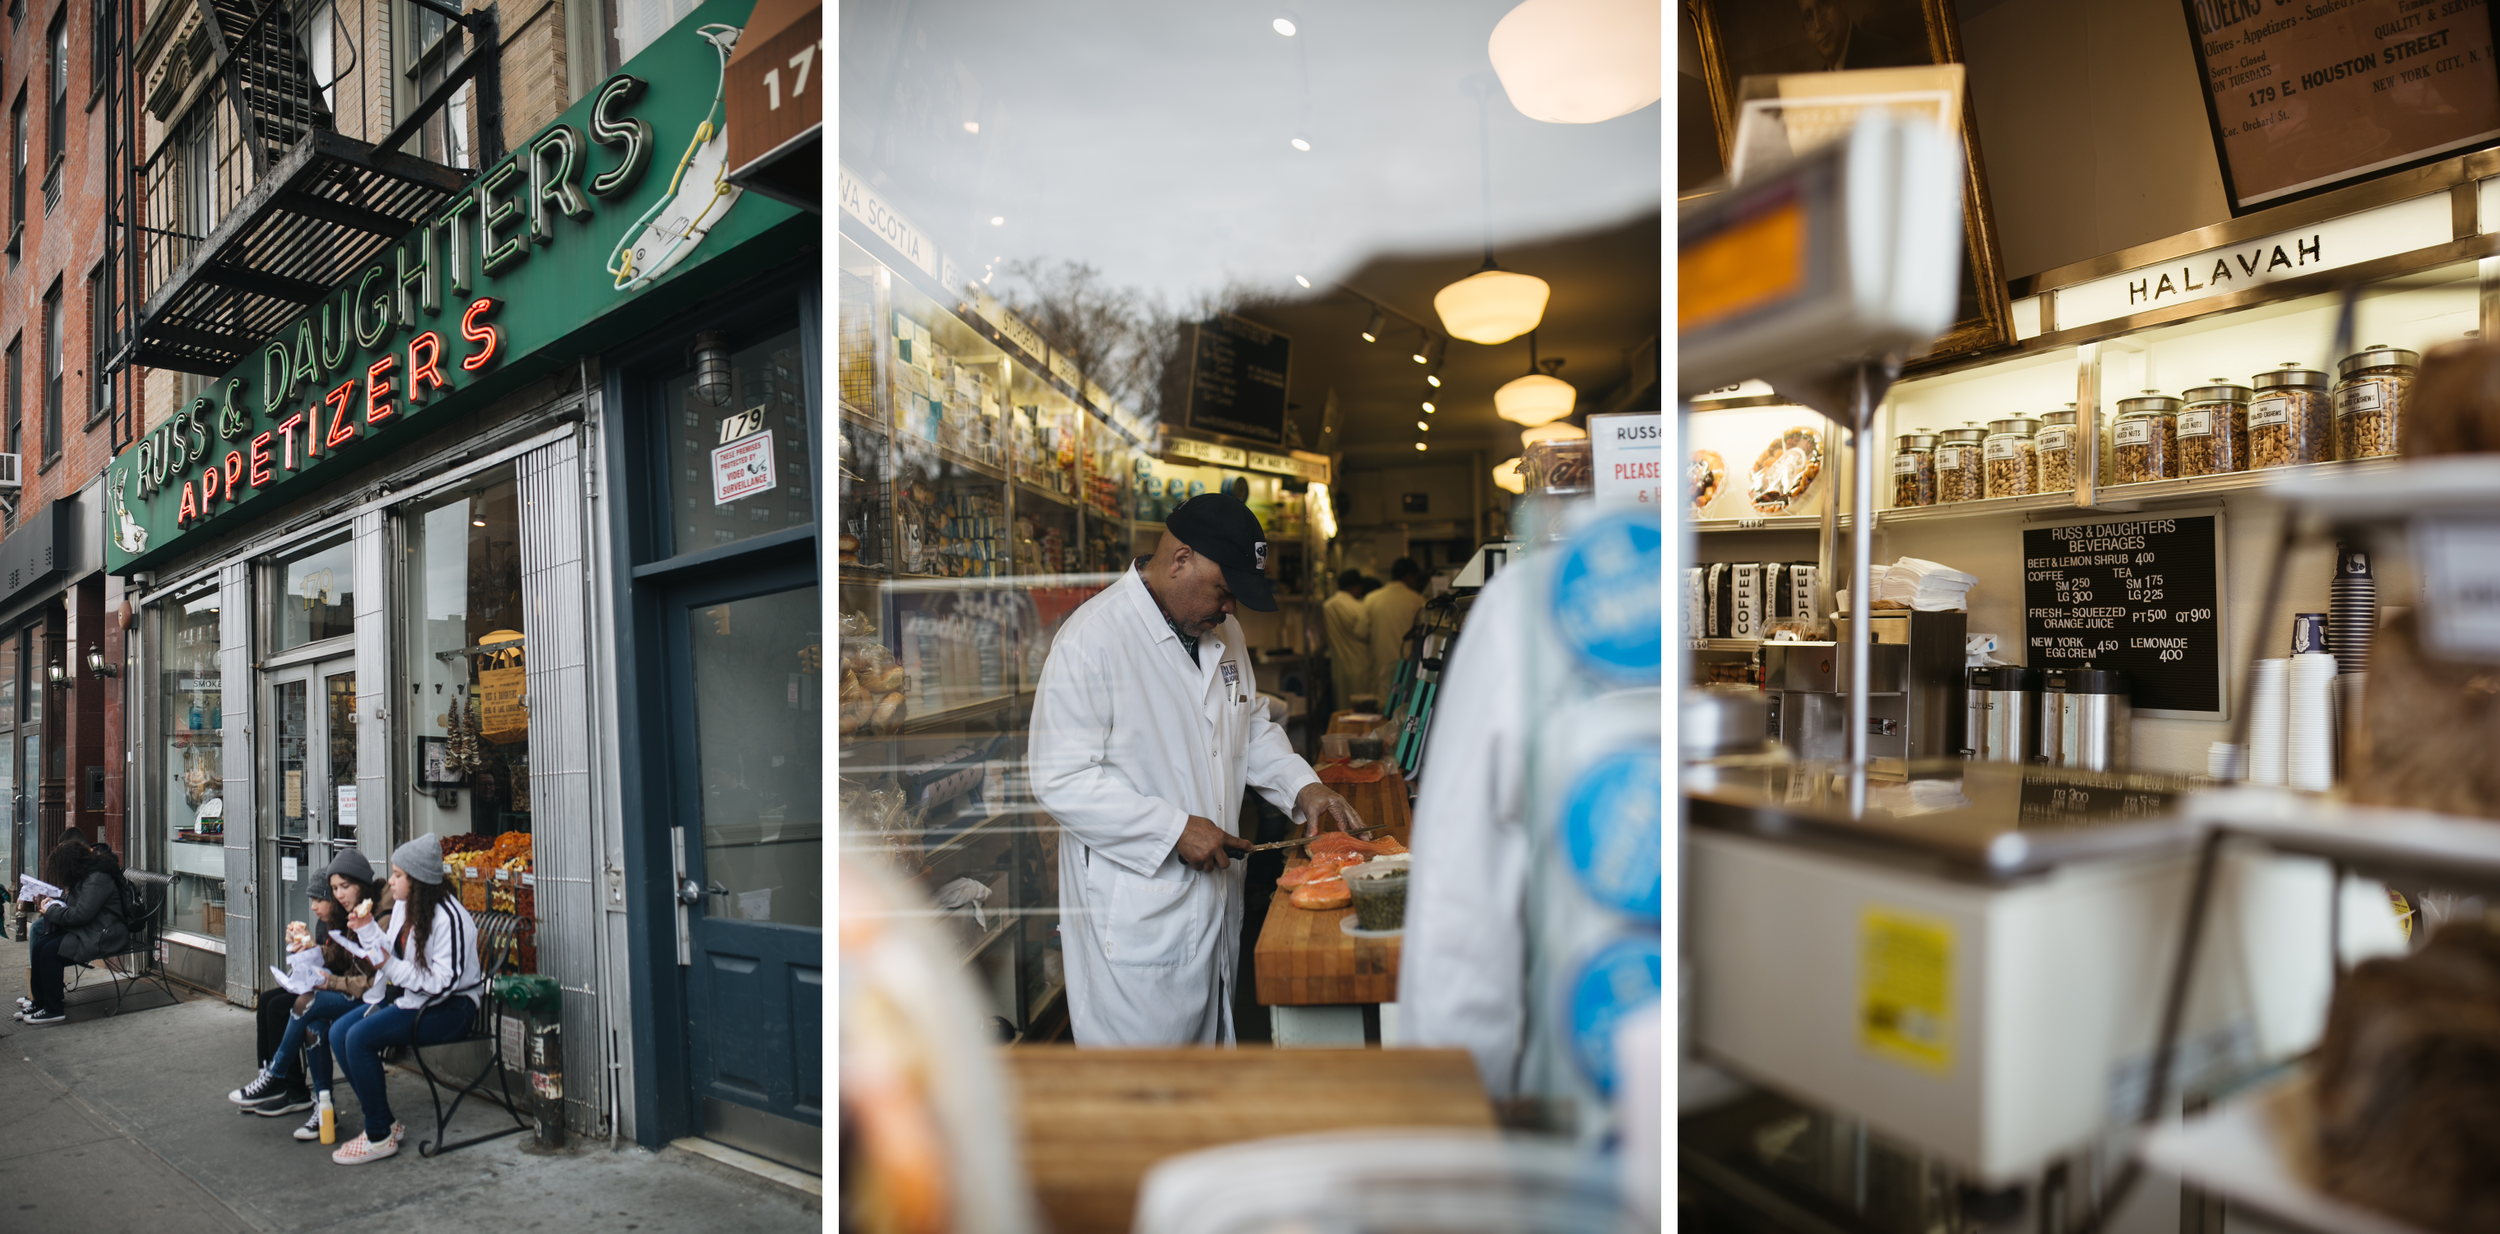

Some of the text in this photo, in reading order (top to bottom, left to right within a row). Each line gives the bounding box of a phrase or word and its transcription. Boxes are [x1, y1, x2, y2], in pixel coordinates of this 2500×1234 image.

[2374, 12, 2422, 40] QUALITY
[2427, 9, 2437, 22] &
[2205, 40, 2235, 58] Olives
[2243, 16, 2297, 45] Appetizers
[2211, 65, 2232, 79] Sorry
[2240, 49, 2267, 69] Closed
[2248, 28, 2450, 107] 179 E. HOUSTON STREET
[2372, 75, 2396, 93] NEW
[2400, 64, 2431, 84] YORK
[2436, 54, 2465, 74] CITY,
[2469, 49, 2481, 63] N.
[763, 39, 822, 111] 17
[2213, 63, 2273, 93] ON TUESDAYS
[2222, 110, 2290, 138] Cor. Orchard St.
[840, 172, 920, 261] VA SCOTIA
[2129, 234, 2320, 306] HALAVAH
[137, 73, 654, 500] RUSS & DAUGHTERS
[1003, 312, 1040, 355] STURGEON
[2353, 394, 2375, 405] CASHEWS
[177, 297, 505, 531] APPETIZERS
[2263, 410, 2282, 418] CASHEWS
[724, 408, 762, 441] 179
[2128, 429, 2141, 437] NUTS
[2180, 420, 2203, 430] MIXED NUTS
[720, 441, 761, 461] THESE PREMISES
[720, 453, 756, 471] PROTECTED BY
[1615, 462, 1660, 480] PLEASE
[726, 468, 744, 481] VIDEO
[722, 473, 767, 495] SURVEILLANCE
[1638, 490, 1650, 503] &
[1739, 520, 1763, 528] 5195
[2052, 519, 2176, 540] RUSS & DAUGHTERS
[2069, 536, 2146, 553] BEVERAGES
[2028, 552, 2155, 568] BEET & LEMON SHRUB 400
[2028, 570, 2064, 582] COFFEE
[2112, 567, 2133, 578] TEA
[300, 567, 333, 611] 179
[2055, 577, 2090, 591] SM 250
[2126, 575, 2163, 589] SM 175
[1681, 570, 1692, 634] COFFEE
[1737, 568, 1750, 634] COFFEE
[2057, 590, 2093, 604] LG 300
[2128, 589, 2164, 603] LG 225
[2044, 618, 2114, 629] ORANGE JUICE
[2031, 637, 2084, 648] NEW YORK
[2046, 640, 2119, 659] EGG CREM 450
[2130, 637, 2188, 649] LEMONADE
[2159, 649, 2183, 663] 400
